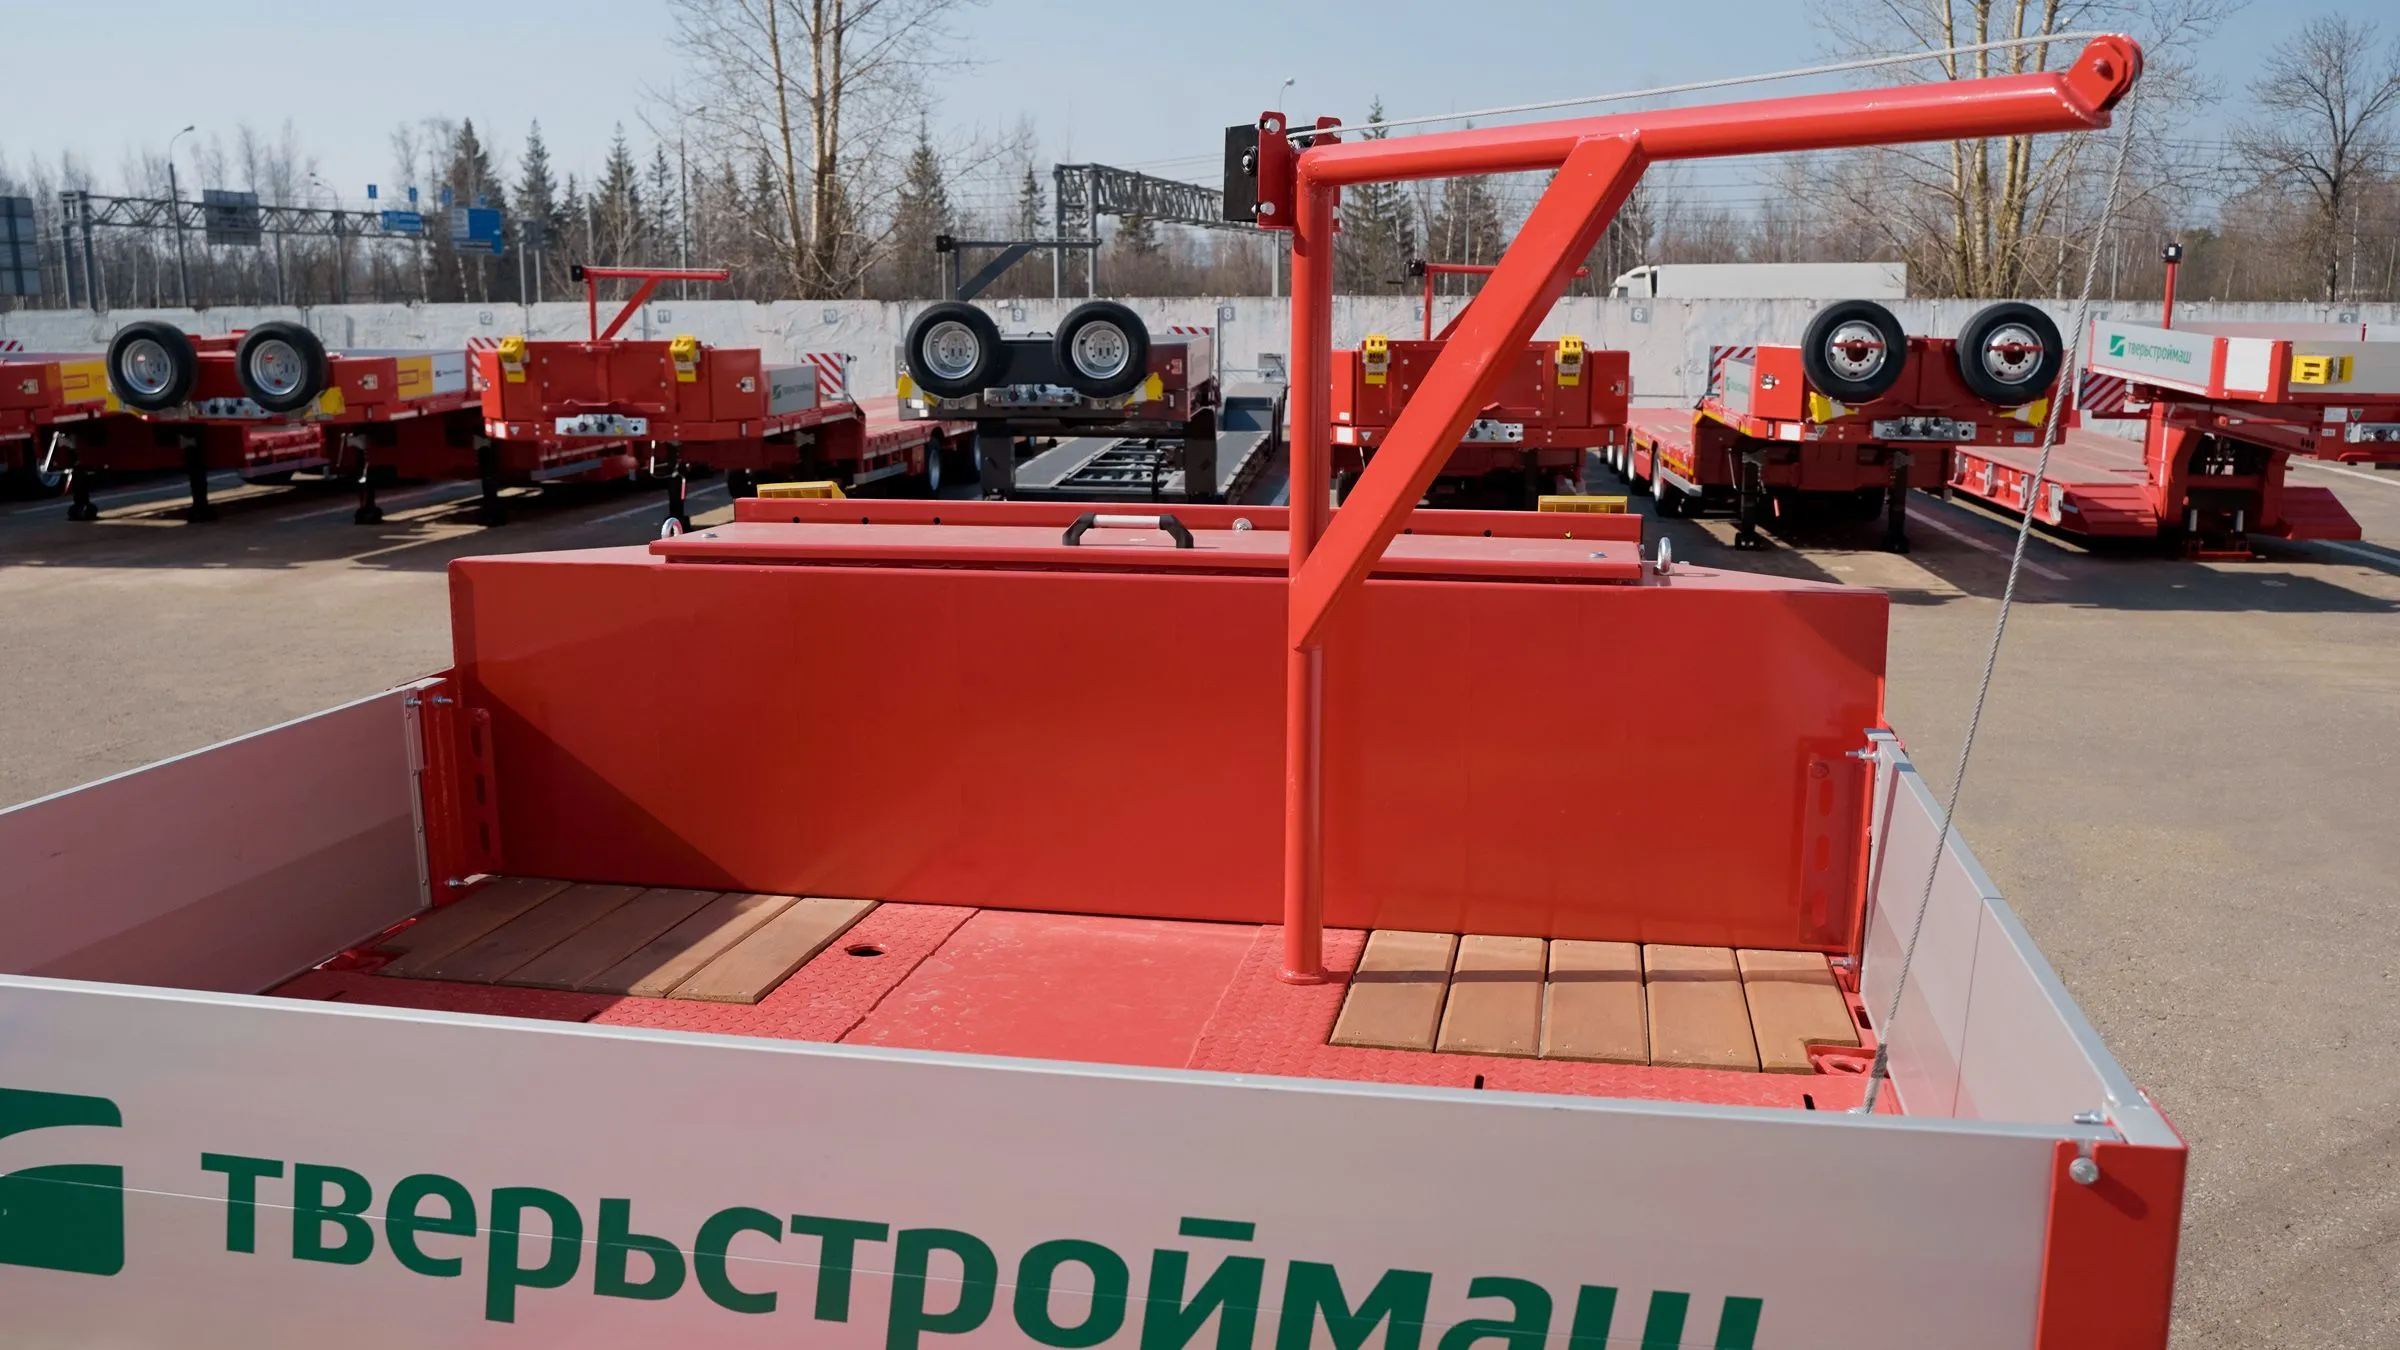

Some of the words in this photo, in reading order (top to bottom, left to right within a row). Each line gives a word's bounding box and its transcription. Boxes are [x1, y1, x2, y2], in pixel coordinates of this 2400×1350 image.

[658, 311, 670, 322] 11
[1014, 309, 1022, 320] 9
[1224, 308, 1232, 319] 8
[1634, 308, 1643, 320] 6
[2128, 341, 2192, 364] тверьстроймаш
